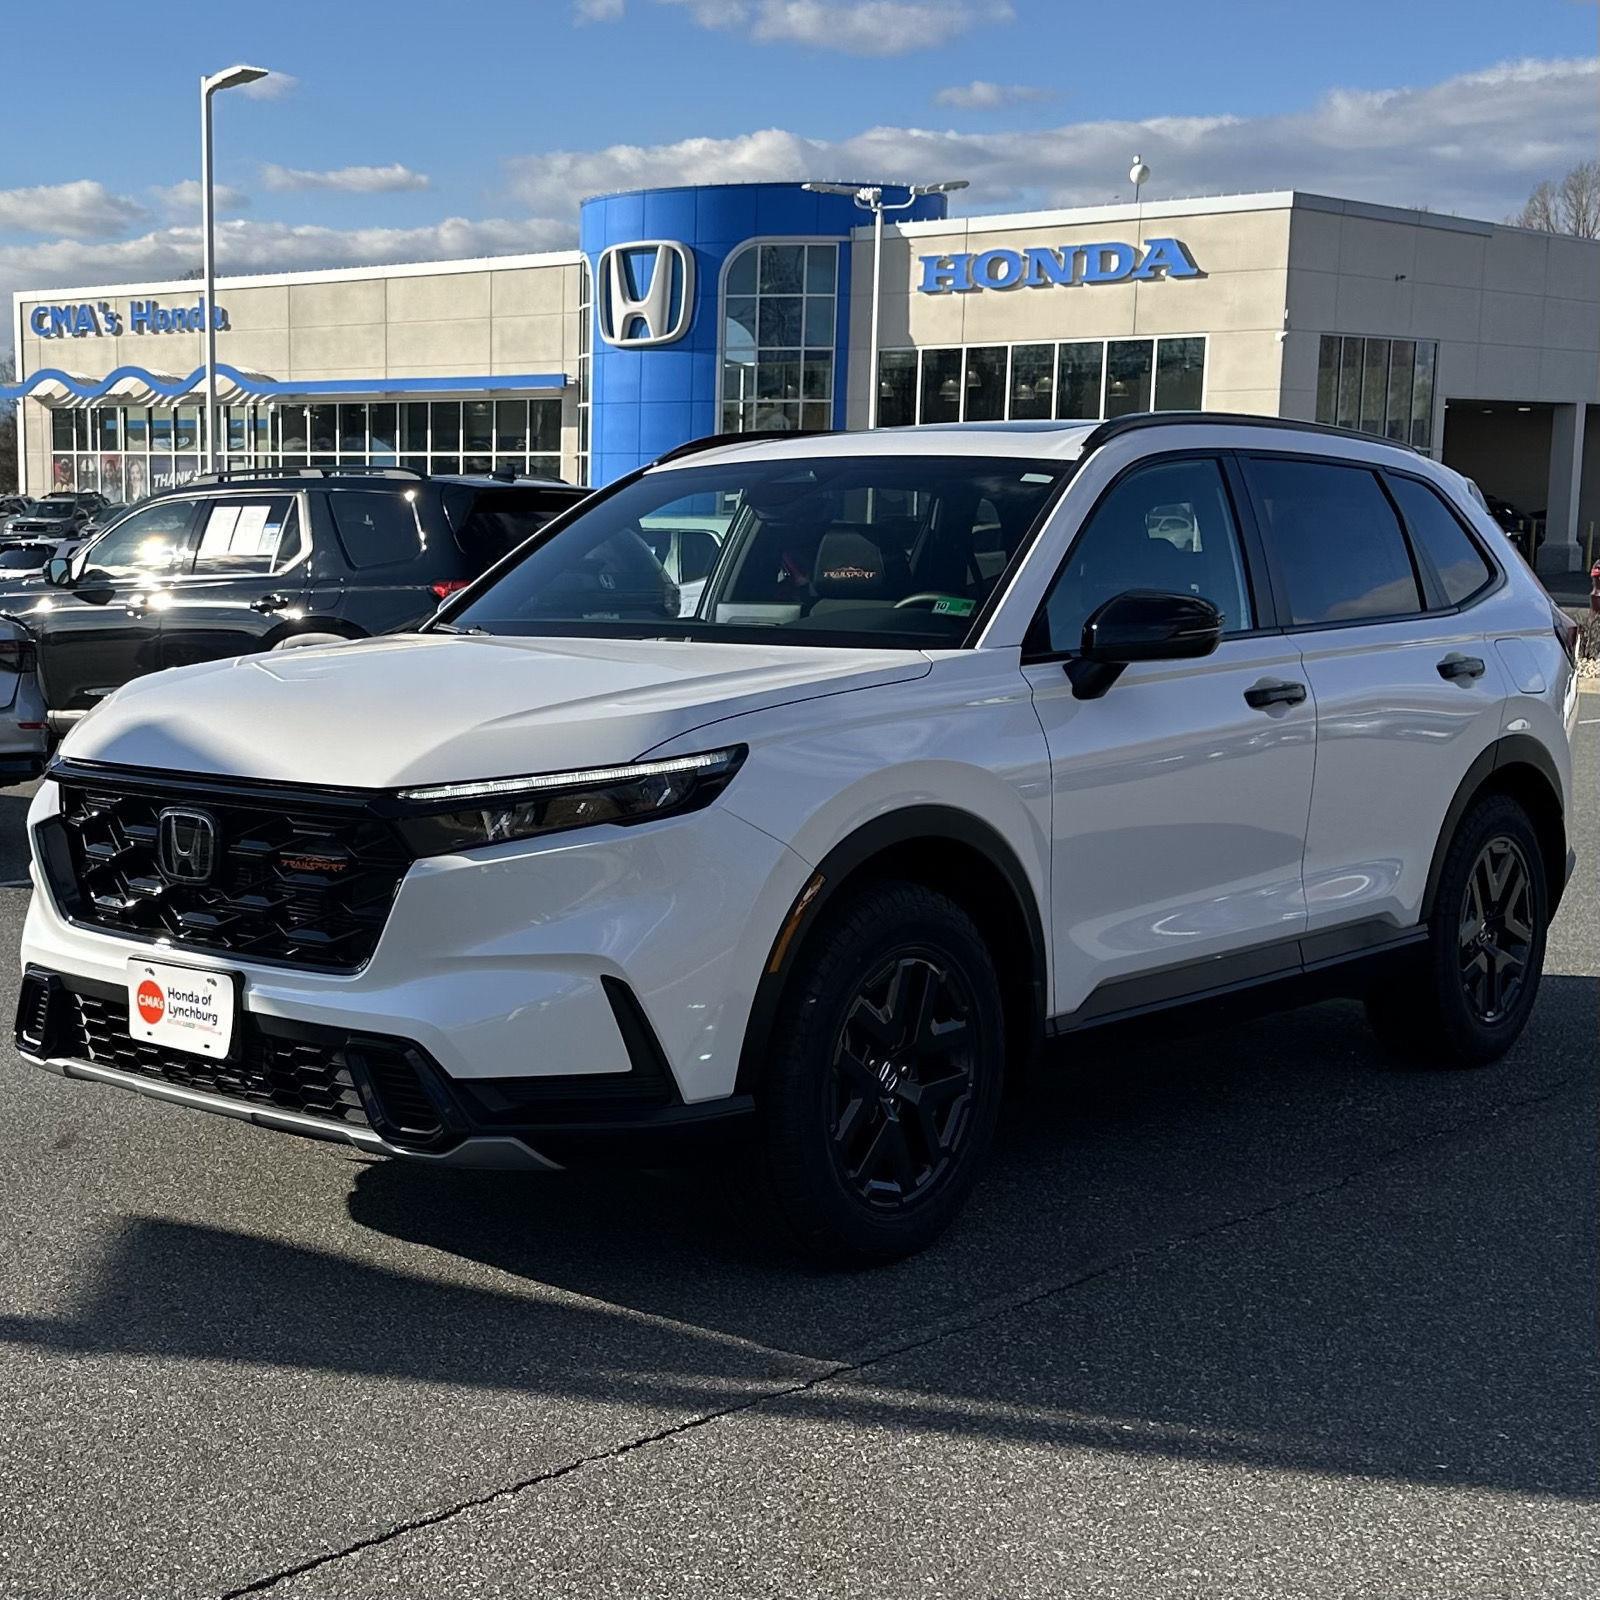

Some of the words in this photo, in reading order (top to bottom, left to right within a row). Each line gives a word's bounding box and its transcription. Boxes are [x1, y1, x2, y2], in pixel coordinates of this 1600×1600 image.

[917, 238, 1199, 293] HONDA
[31, 302, 118, 337] CMA's
[168, 987, 200, 1003] Honda
[201, 994, 212, 1006] of
[168, 1002, 218, 1026] Lynchburg
